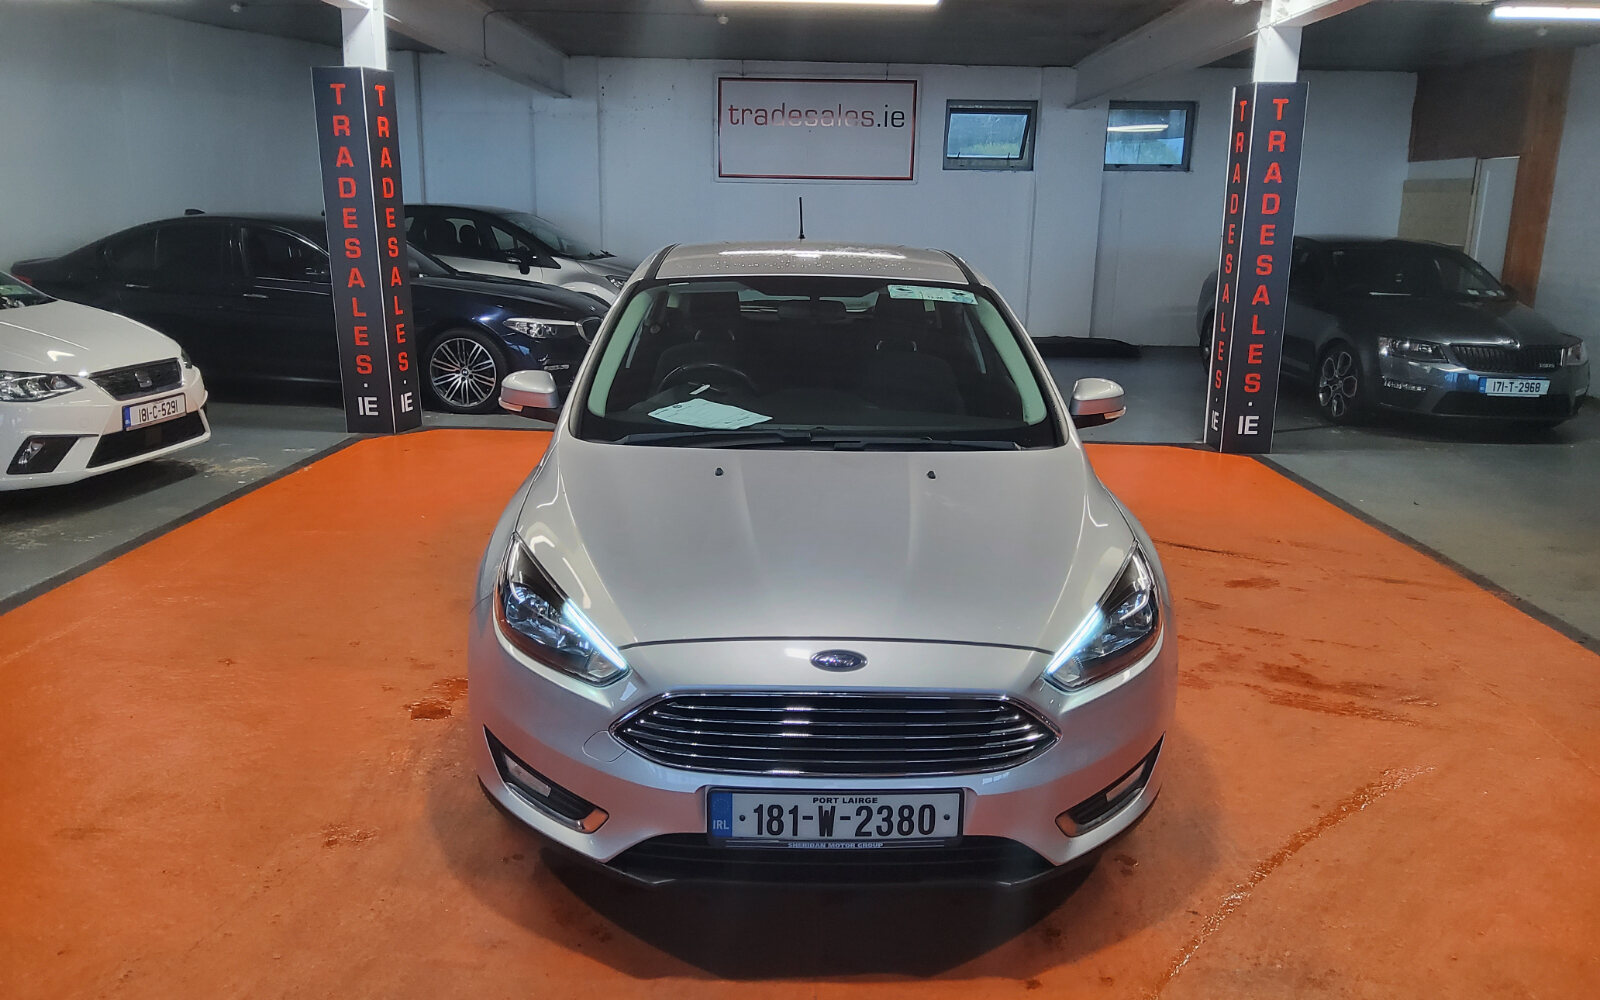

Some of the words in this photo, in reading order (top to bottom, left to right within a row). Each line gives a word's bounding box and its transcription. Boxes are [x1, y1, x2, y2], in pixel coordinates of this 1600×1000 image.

[728, 102, 905, 128] tradesales.ie
[1492, 381, 1541, 393] 171-T-2968
[138, 399, 179, 423] 181-C-5291
[712, 819, 730, 830] IRL
[753, 803, 936, 837] 181-W-2380
[827, 841, 856, 849] MOTOR
[857, 841, 884, 849] GROUP
